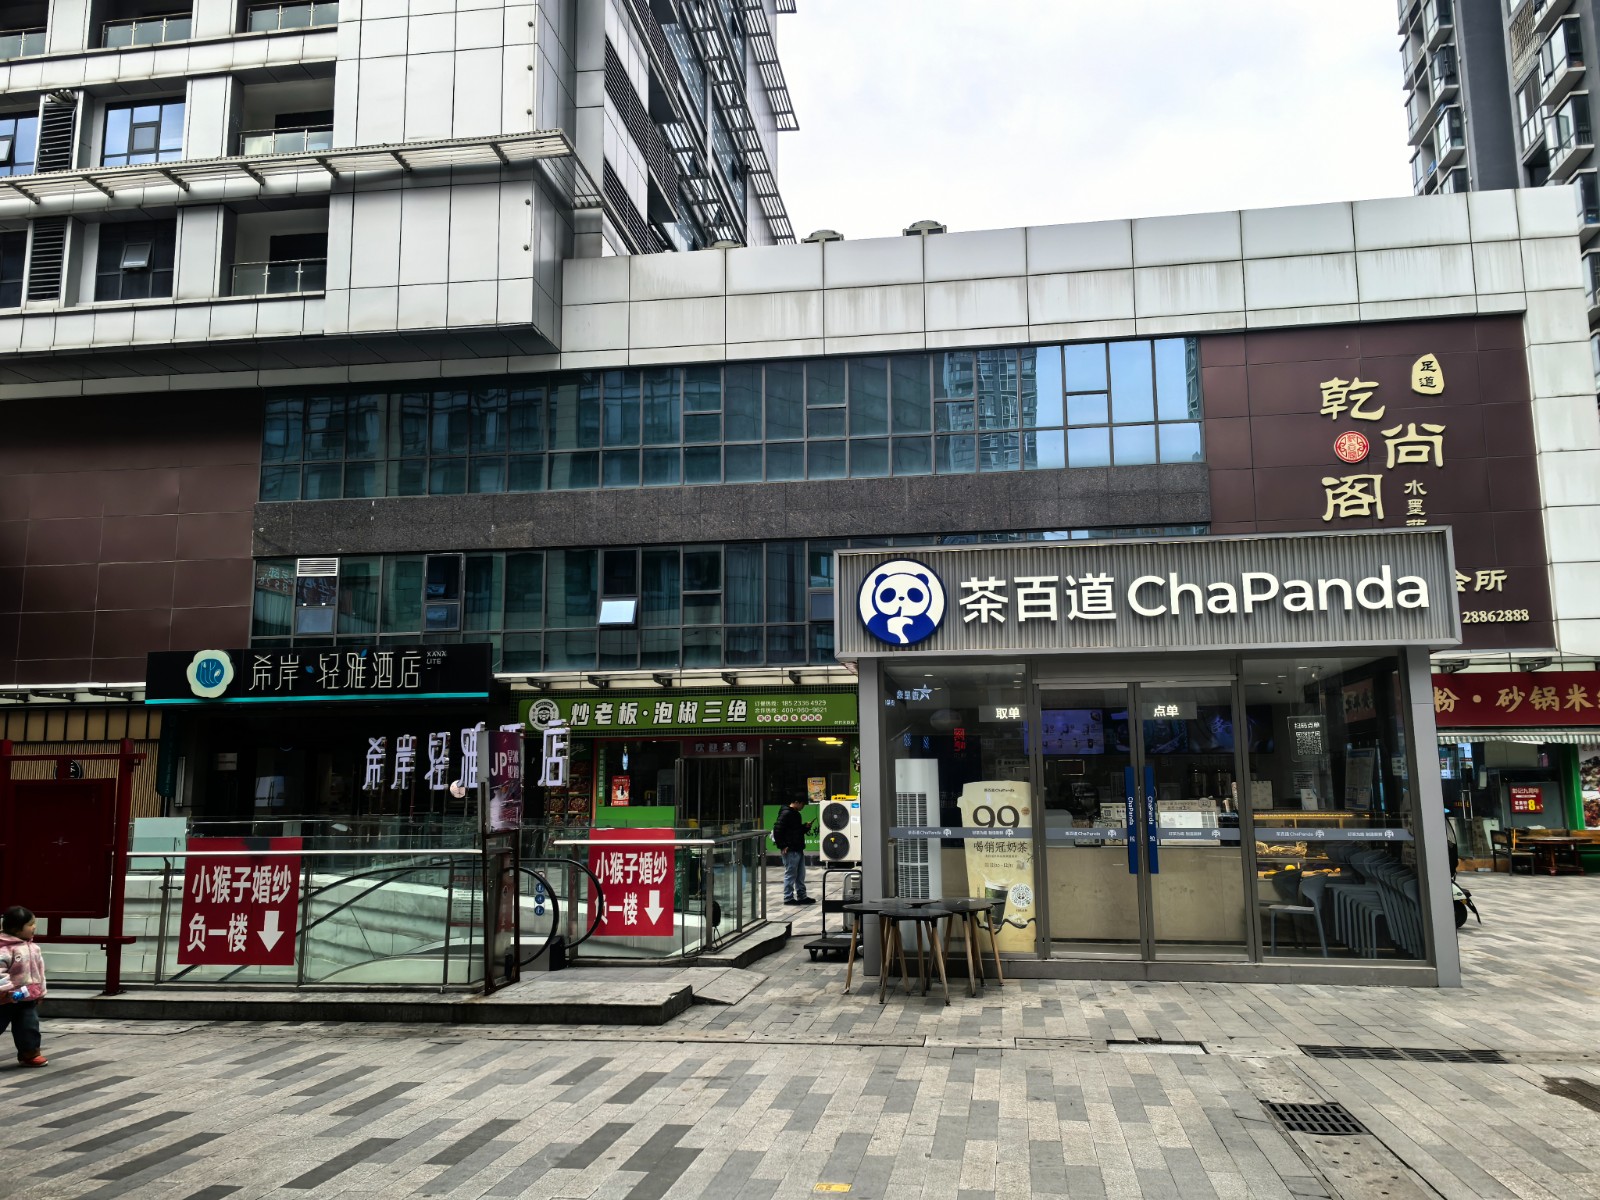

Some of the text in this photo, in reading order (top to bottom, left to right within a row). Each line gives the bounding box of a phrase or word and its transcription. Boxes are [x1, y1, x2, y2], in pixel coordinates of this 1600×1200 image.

[1418, 360, 1437, 388] 足道
[958, 565, 1430, 623] 茶百道 ChaPanda
[1462, 609, 1529, 624] 28862888
[1154, 704, 1179, 717] 点单
[1433, 684, 1600, 713] 粉·砂锅米
[570, 700, 747, 726] 炒老板·泡椒三绝
[995, 707, 1020, 720] 取单
[1294, 721, 1320, 729] 扫码点单
[362, 719, 568, 791] 希岸轻雅店
[491, 752, 507, 777] JP
[972, 805, 1020, 828] 99
[973, 841, 1028, 853] 喝销冠奶茶
[595, 851, 668, 885] 小猴子婚纱
[191, 864, 292, 904] 小猴子婚纱
[593, 892, 638, 926] 负一楼
[187, 912, 248, 953] 负一楼
